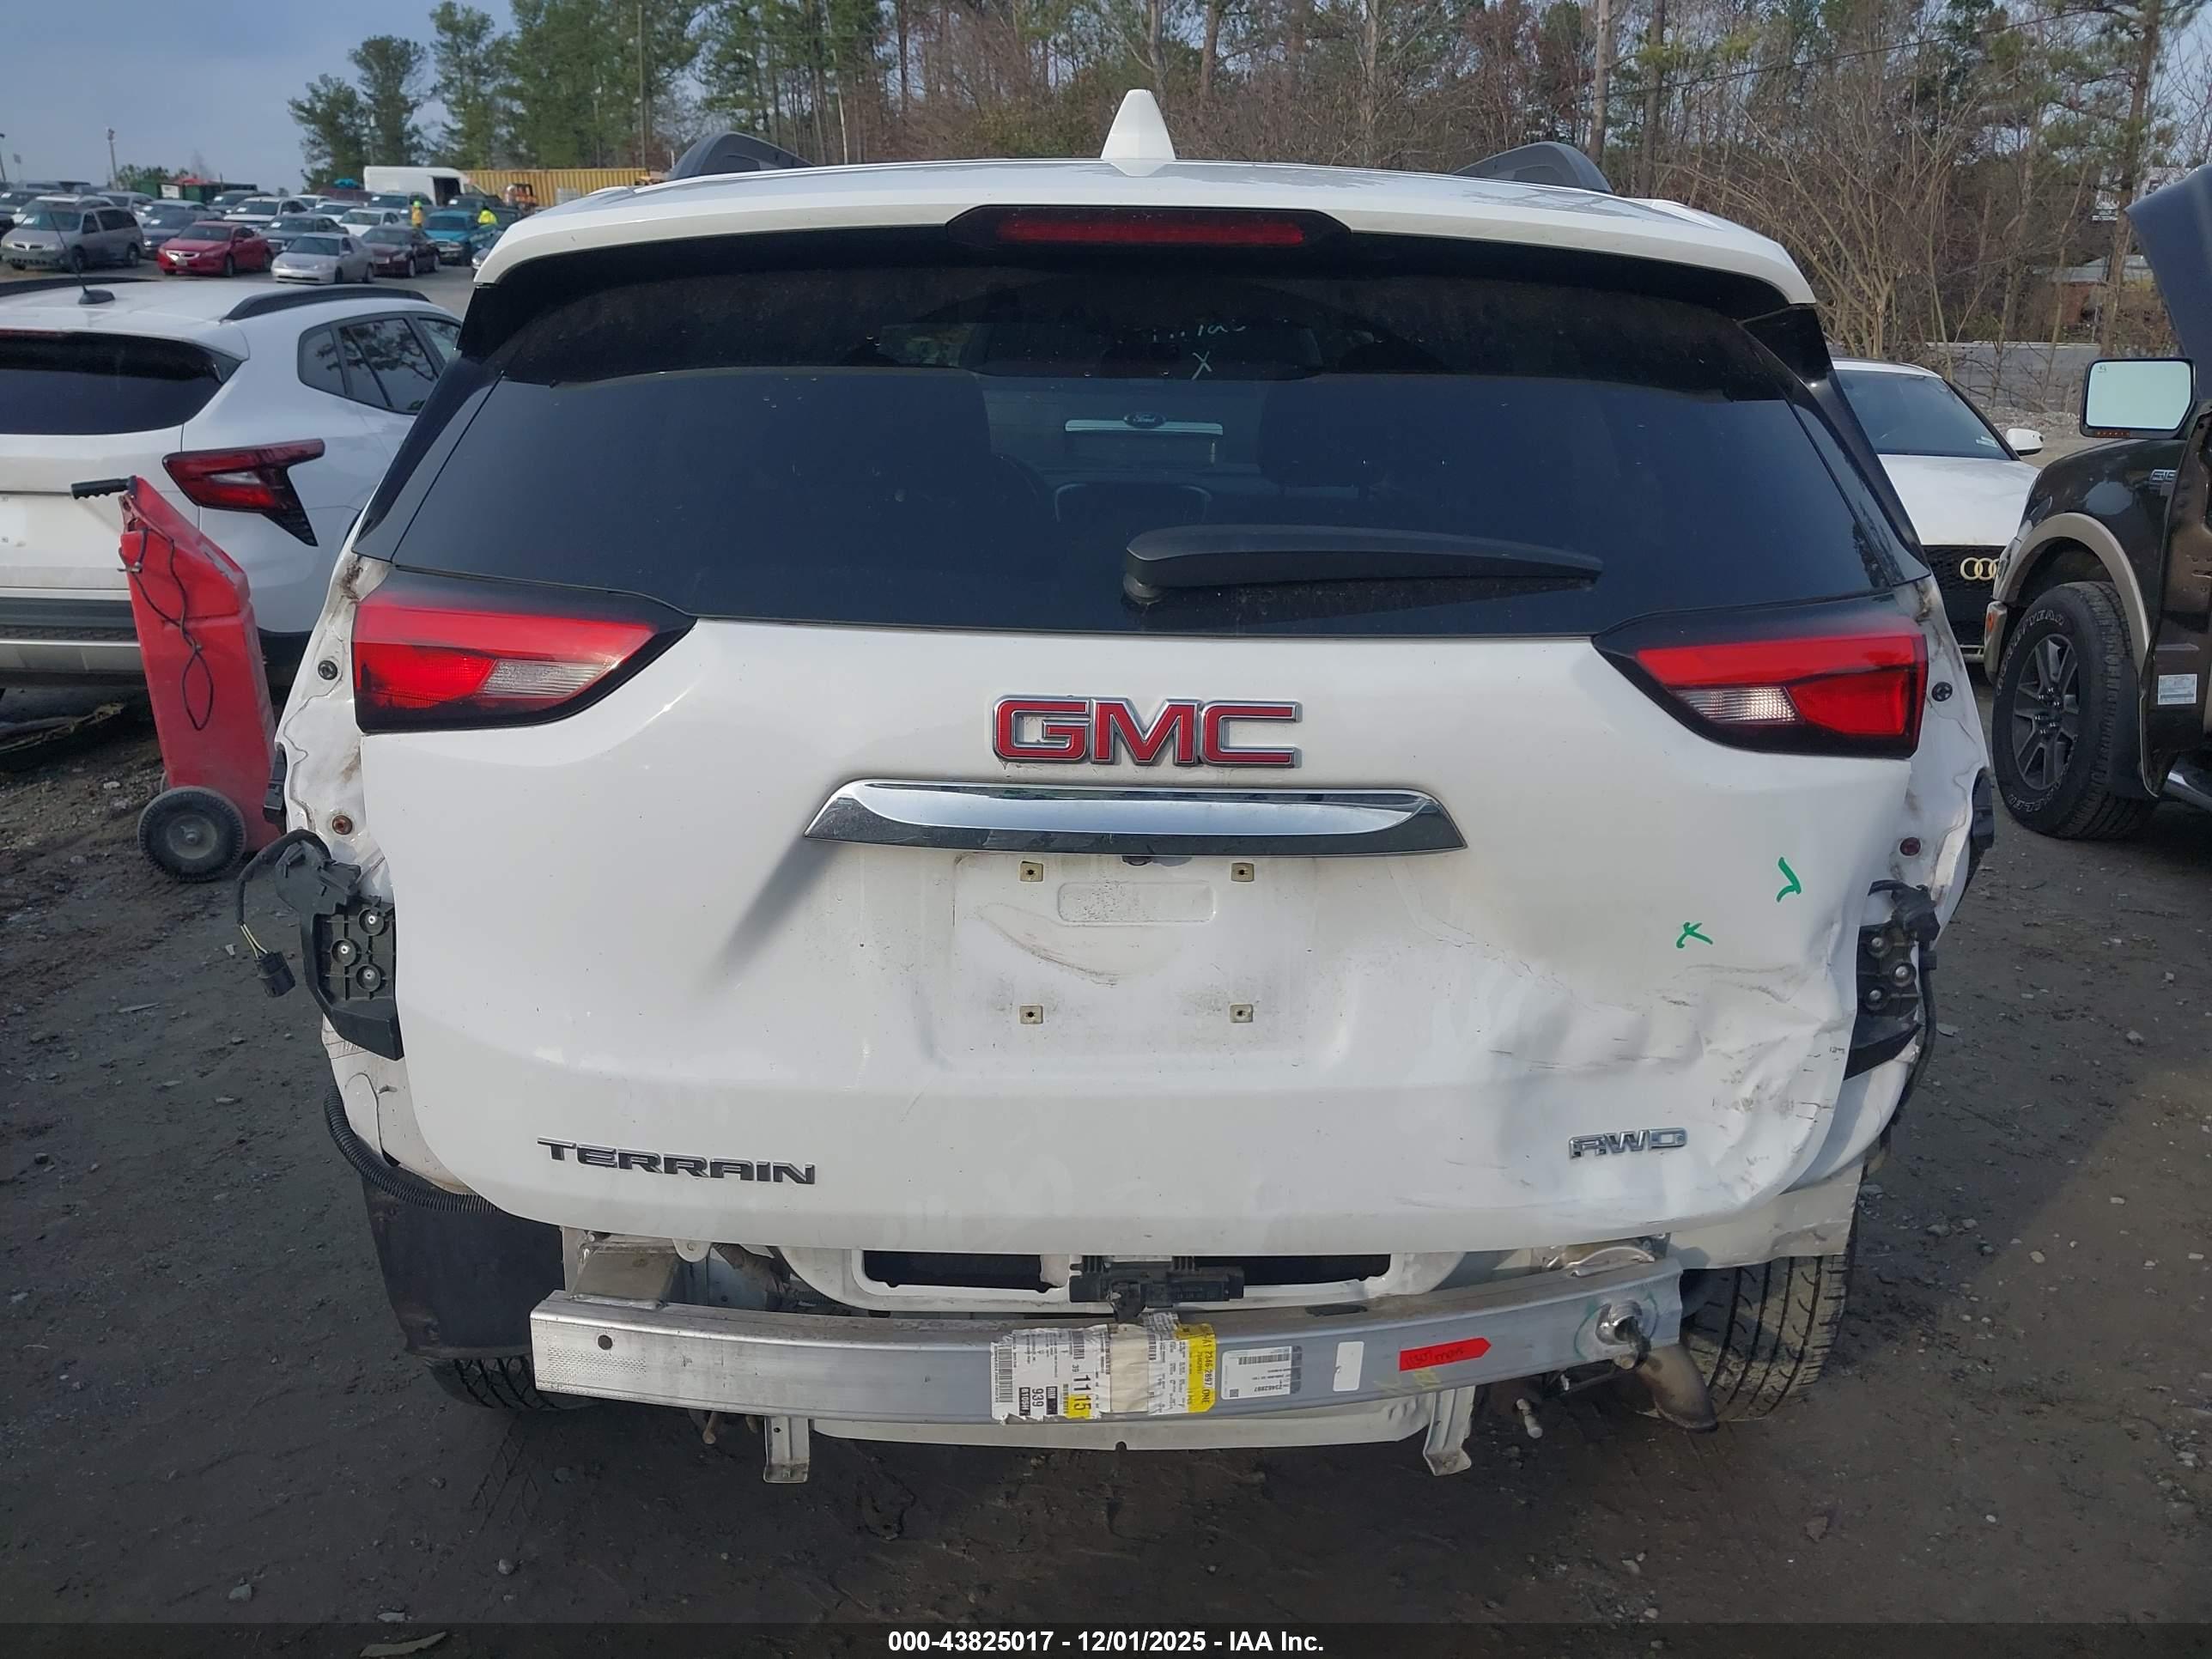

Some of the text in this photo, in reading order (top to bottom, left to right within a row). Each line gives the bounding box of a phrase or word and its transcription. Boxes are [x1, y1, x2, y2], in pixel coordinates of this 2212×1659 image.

[993, 694, 1299, 769] GMC
[1569, 1127, 1688, 1159] AWD
[537, 1136, 816, 1185] TERRAIN
[1031, 1388, 1044, 1407] 939
[1048, 1387, 1056, 1399] RIM
[1073, 1374, 1092, 1411] 11 15
